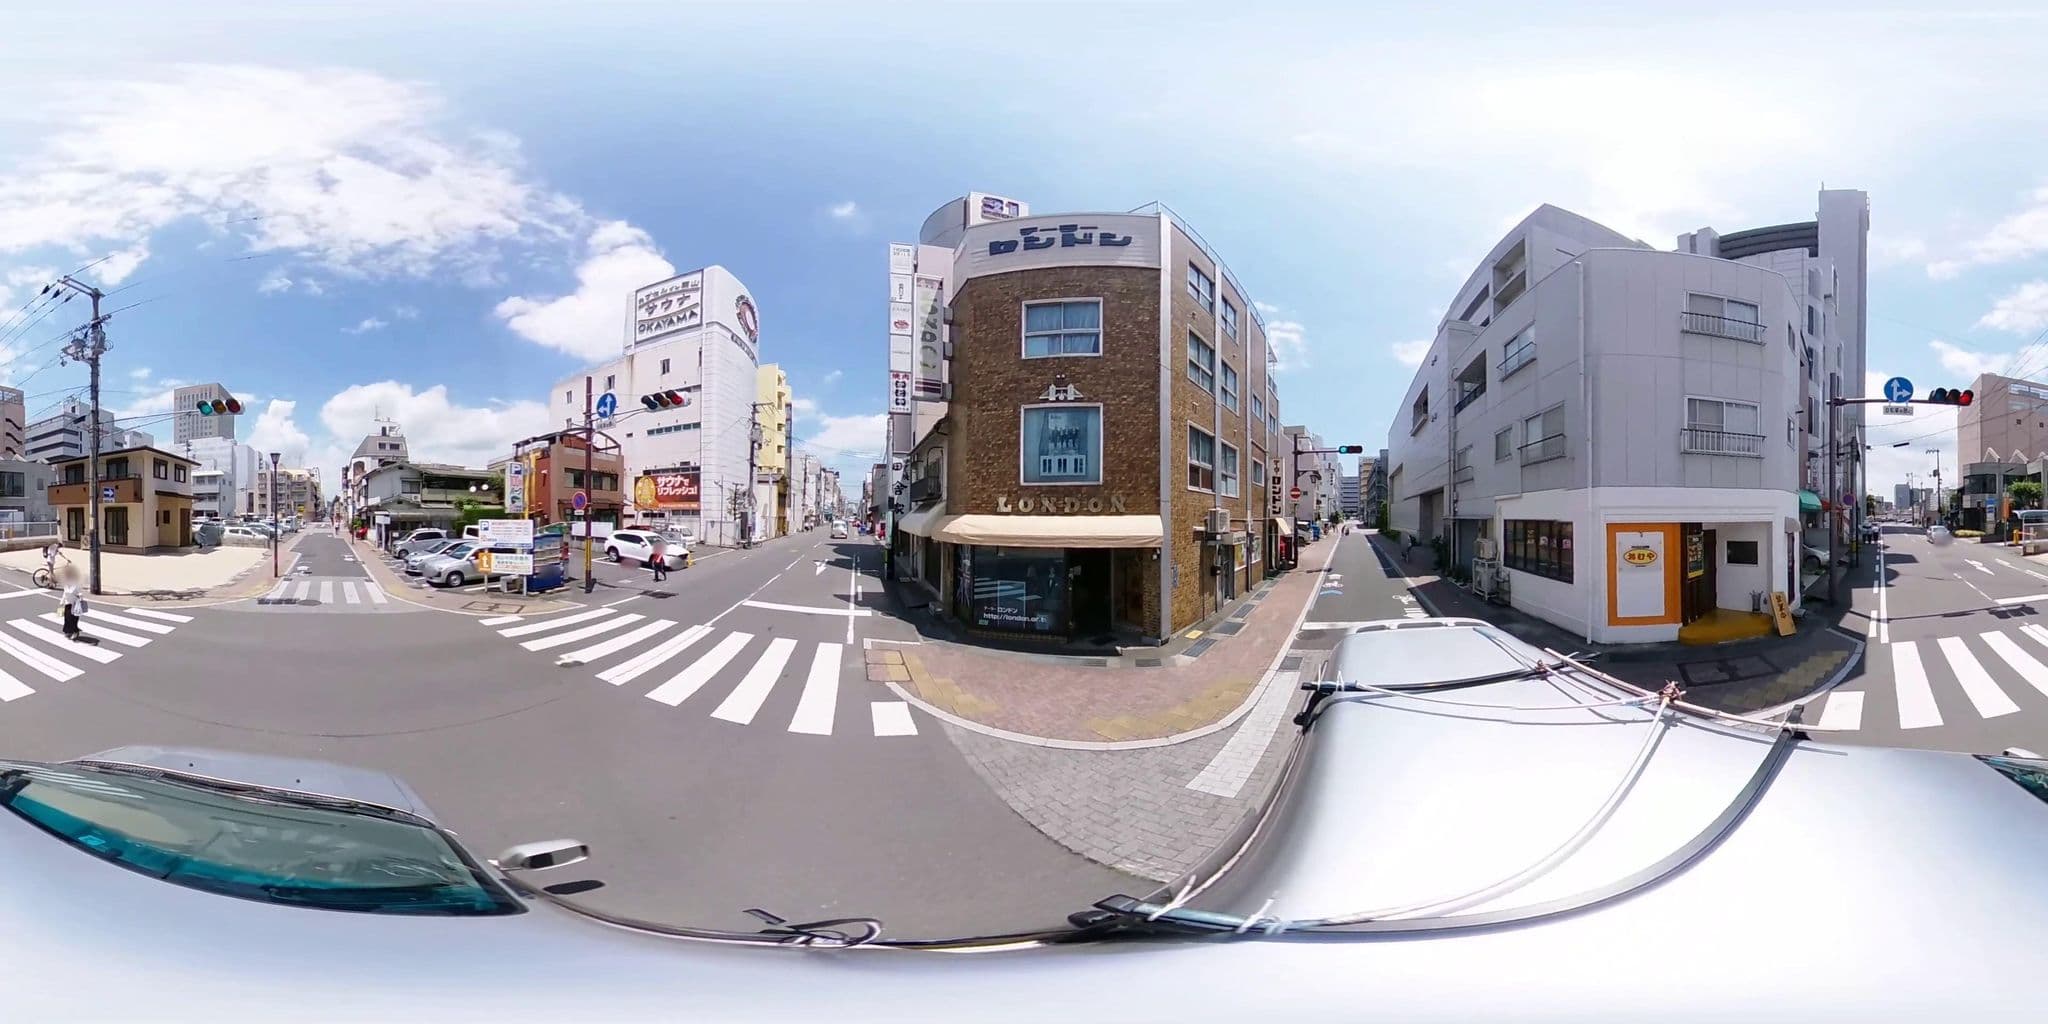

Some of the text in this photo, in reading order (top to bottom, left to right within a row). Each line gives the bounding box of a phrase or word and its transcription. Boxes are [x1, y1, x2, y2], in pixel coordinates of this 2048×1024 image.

[989, 232, 1132, 256] ロンドン
[645, 294, 691, 316] サウナ
[639, 310, 698, 334] OKAYAMA
[657, 475, 689, 487] サウナで
[996, 496, 1126, 513] LONDON
[1272, 476, 1281, 515] ロンドン
[997, 606, 1018, 614] ロンドン
